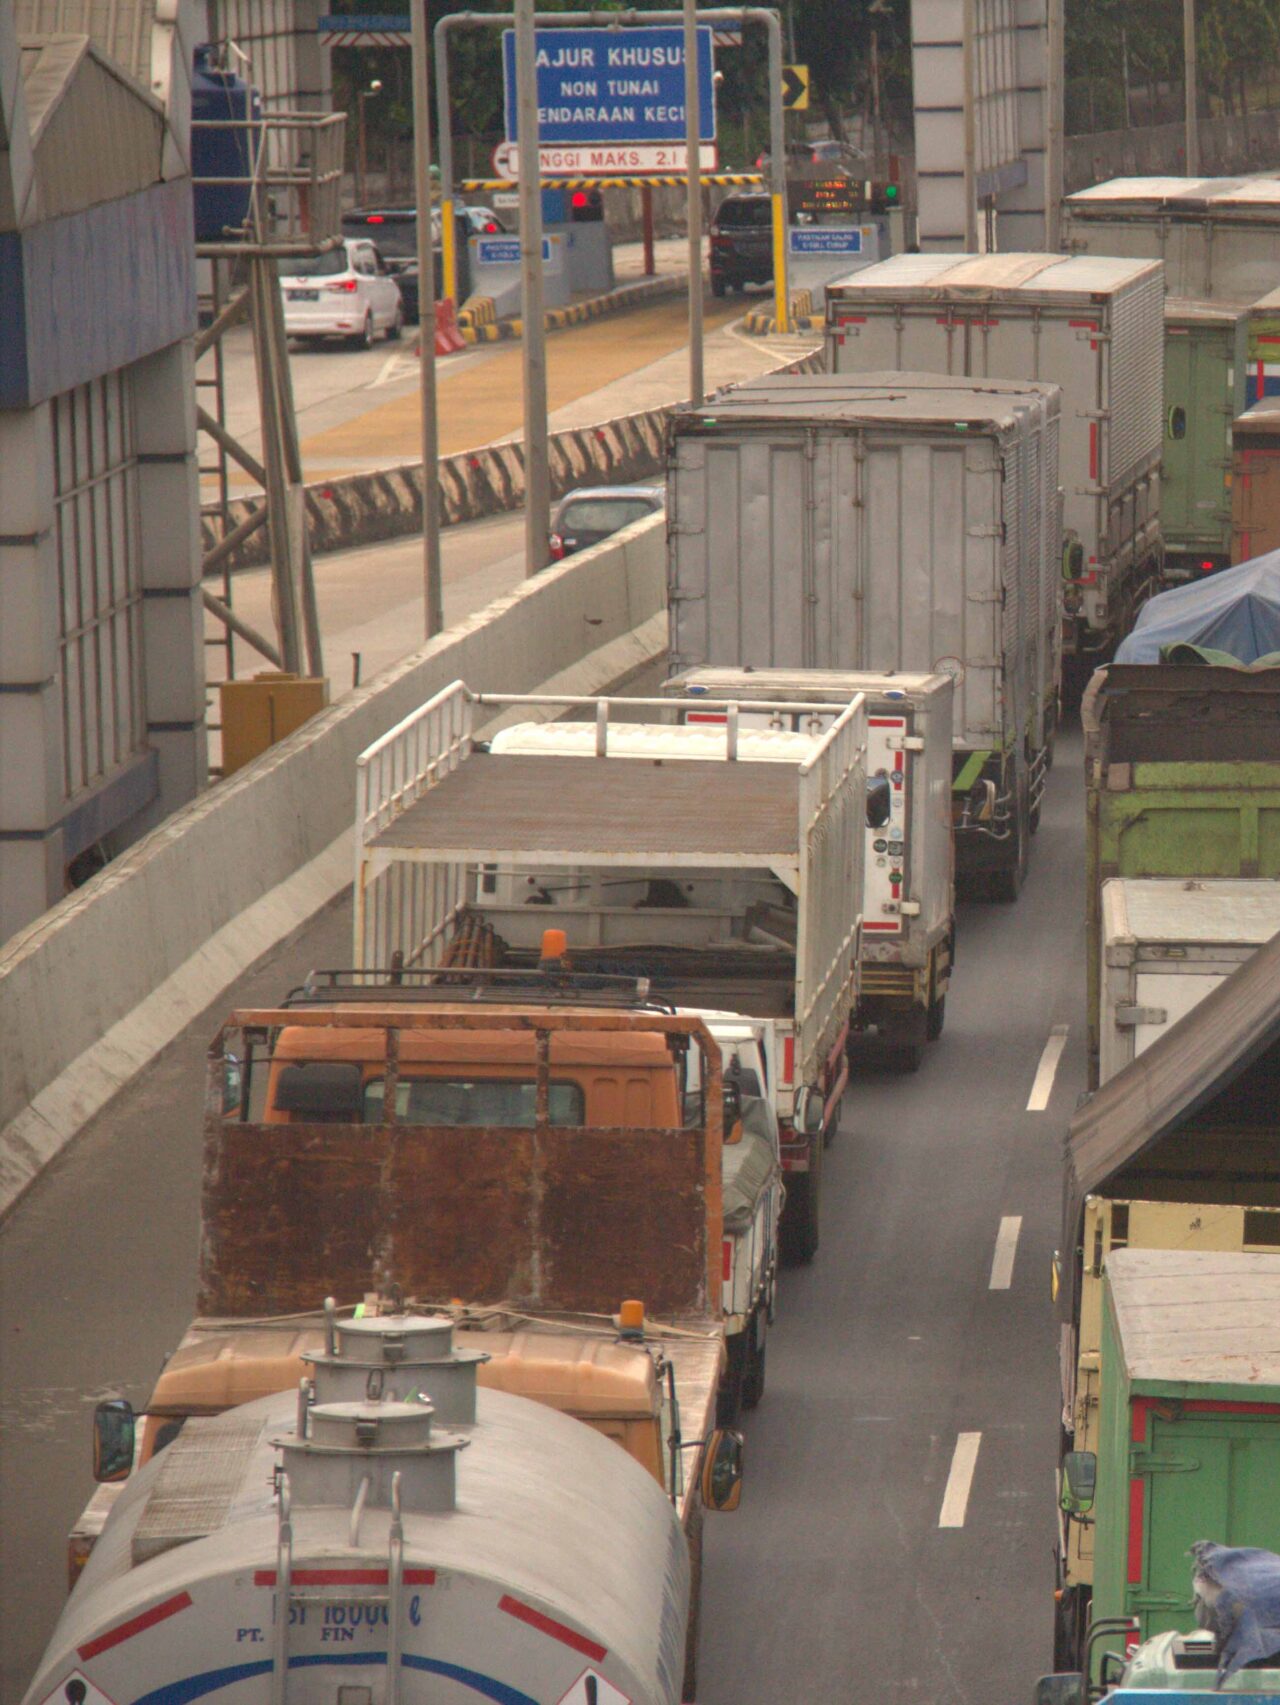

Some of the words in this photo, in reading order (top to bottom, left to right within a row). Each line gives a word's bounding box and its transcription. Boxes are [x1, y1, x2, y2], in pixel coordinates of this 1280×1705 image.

[535, 48, 594, 67] AJUR
[560, 81, 598, 97] NON
[607, 79, 660, 95] TUNAI
[537, 106, 635, 123] ENDARAAN
[644, 106, 686, 122] KECI
[540, 152, 580, 167] NGGI
[236, 1627, 264, 1642] PT.
